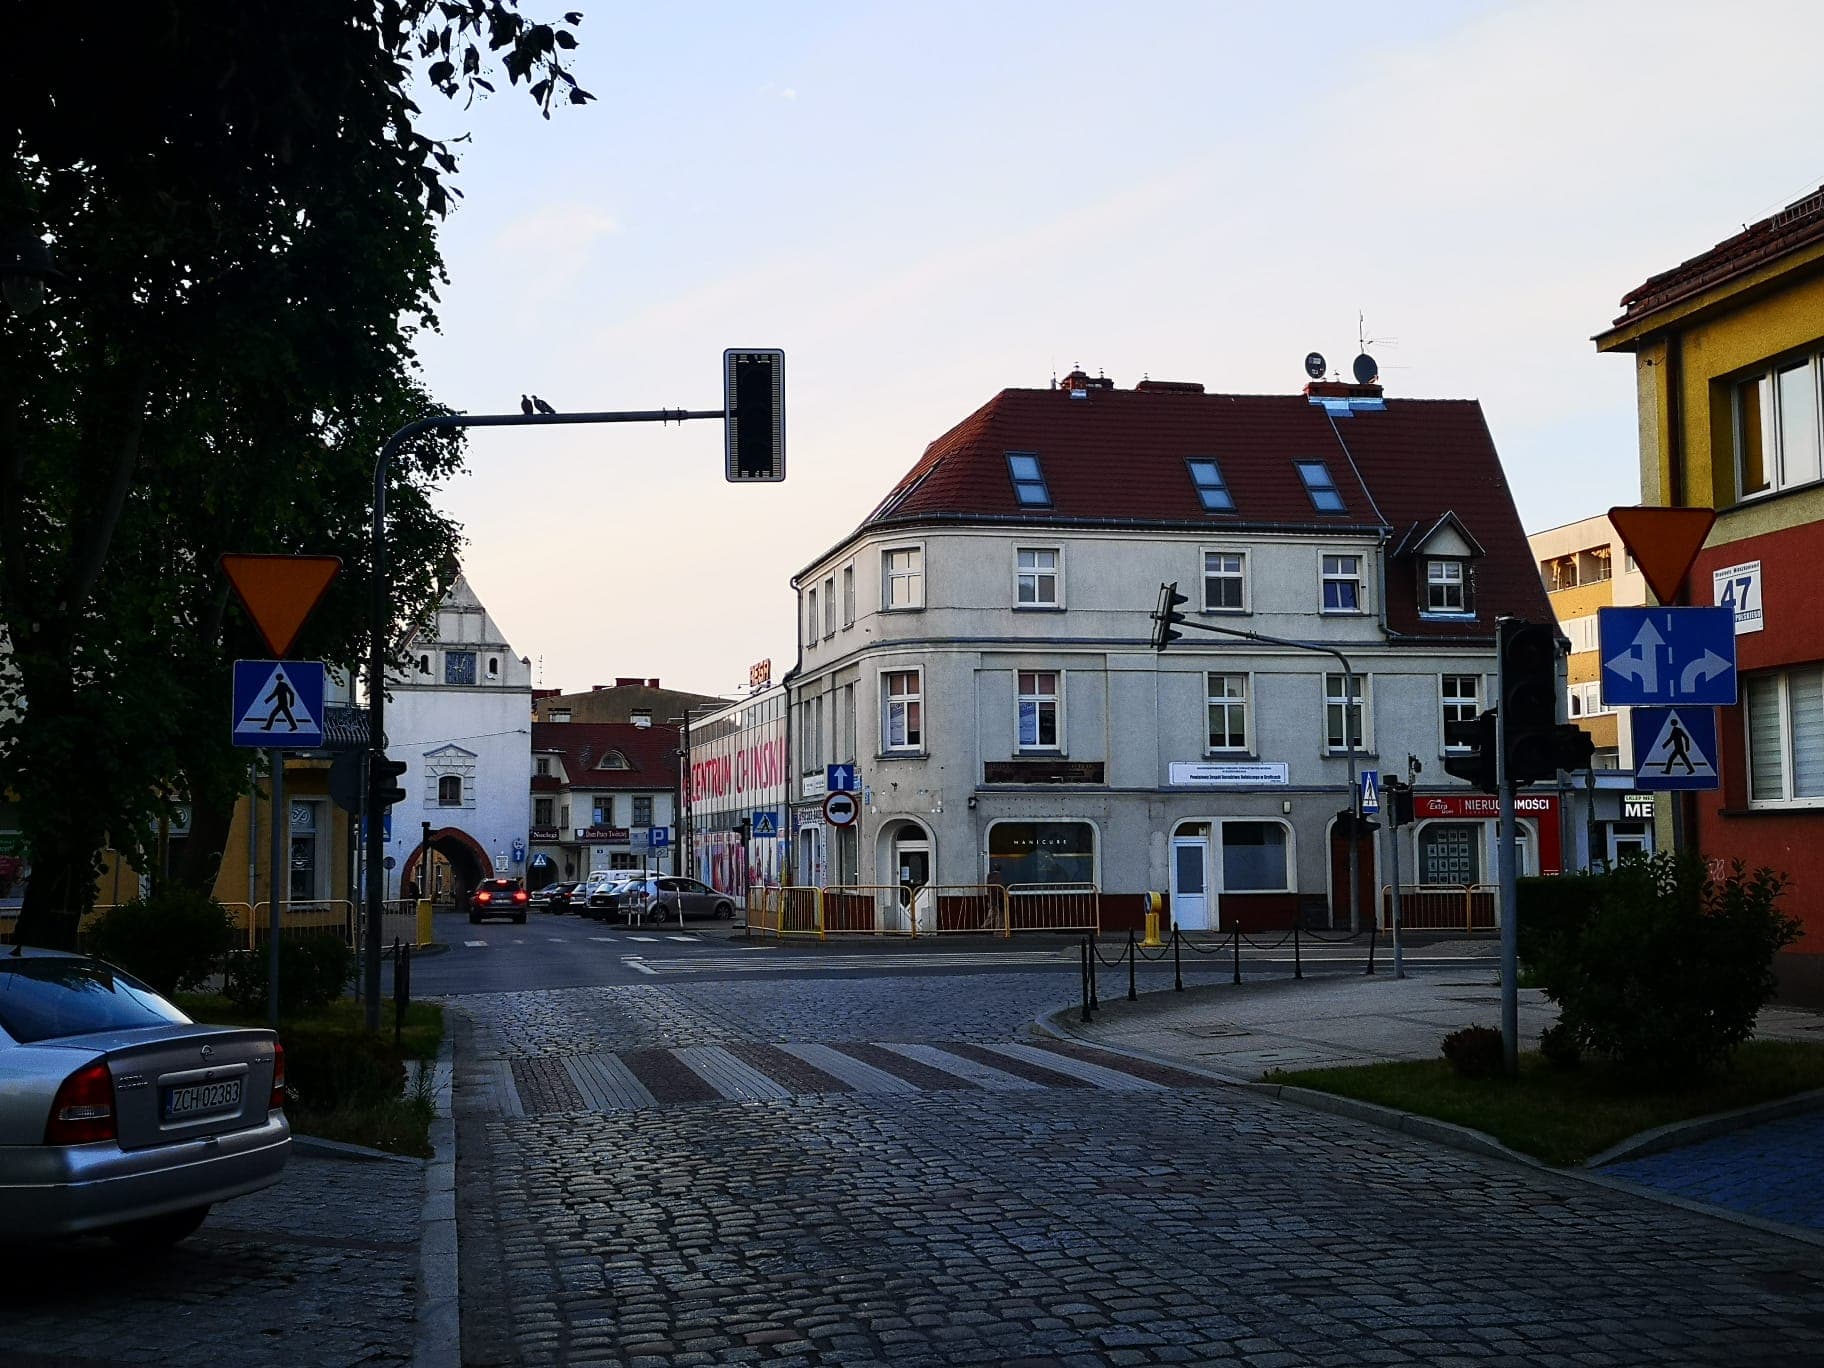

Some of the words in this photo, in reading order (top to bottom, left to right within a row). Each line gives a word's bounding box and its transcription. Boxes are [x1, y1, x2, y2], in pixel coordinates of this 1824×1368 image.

[1721, 576, 1752, 611] 47
[691, 754, 731, 803] CENTRUM
[736, 736, 788, 794] CHIŃSKI
[1464, 797, 1550, 811] NIERUCMOŚCI
[1625, 803, 1655, 817] ME
[653, 830, 665, 845] P
[173, 1089, 199, 1112] ZCH
[202, 1083, 239, 1107] 02383
